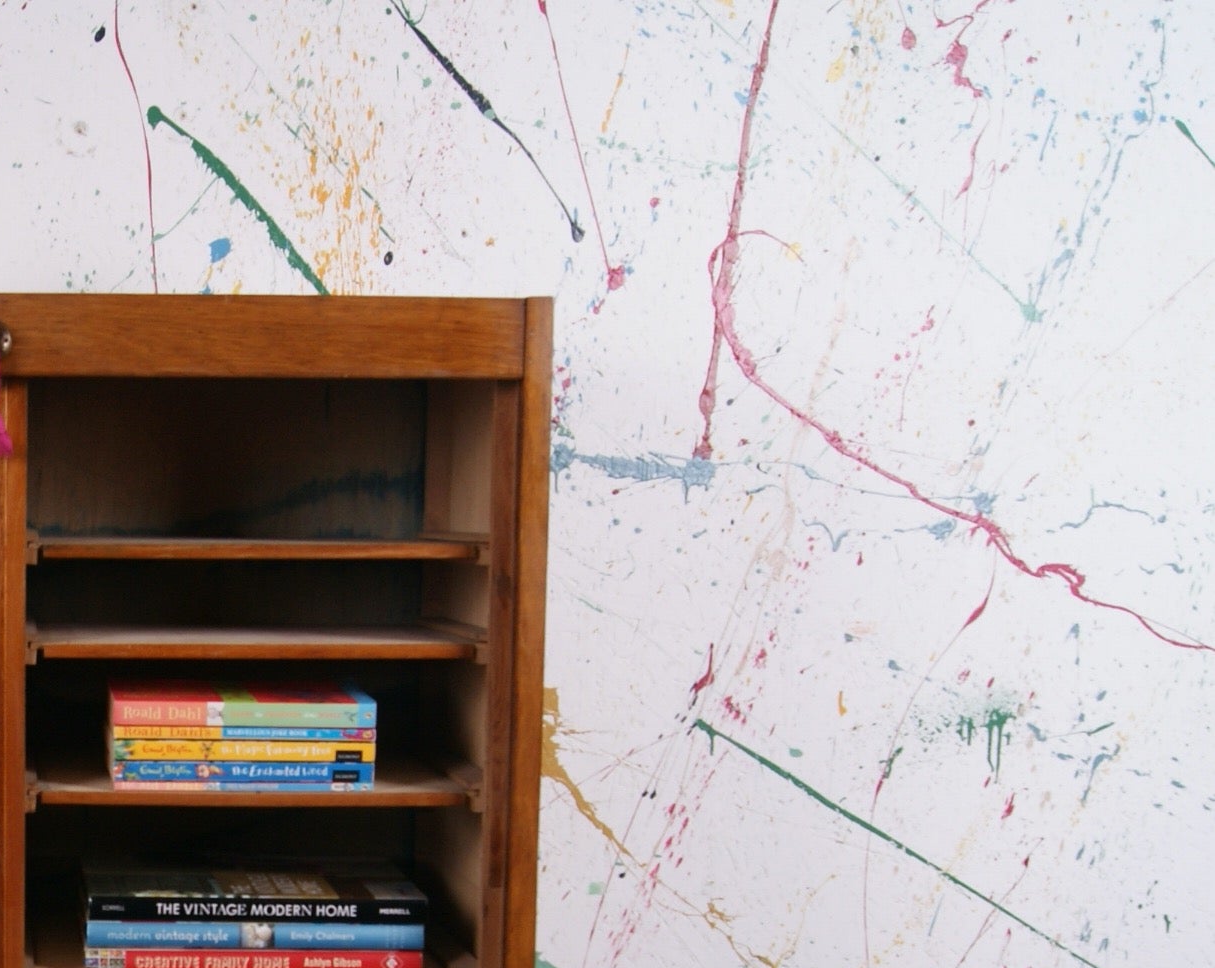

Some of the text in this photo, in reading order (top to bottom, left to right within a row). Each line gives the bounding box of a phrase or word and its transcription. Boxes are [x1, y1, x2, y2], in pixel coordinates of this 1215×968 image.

[123, 706, 201, 720] Roald Dahl
[123, 727, 162, 738] Roald
[156, 902, 358, 917] THE VINTAGE MODERN HOME
[107, 928, 229, 943] modern vintage style
[291, 930, 313, 942] Emily
[303, 957, 362, 968] Ashlyn Gibson
